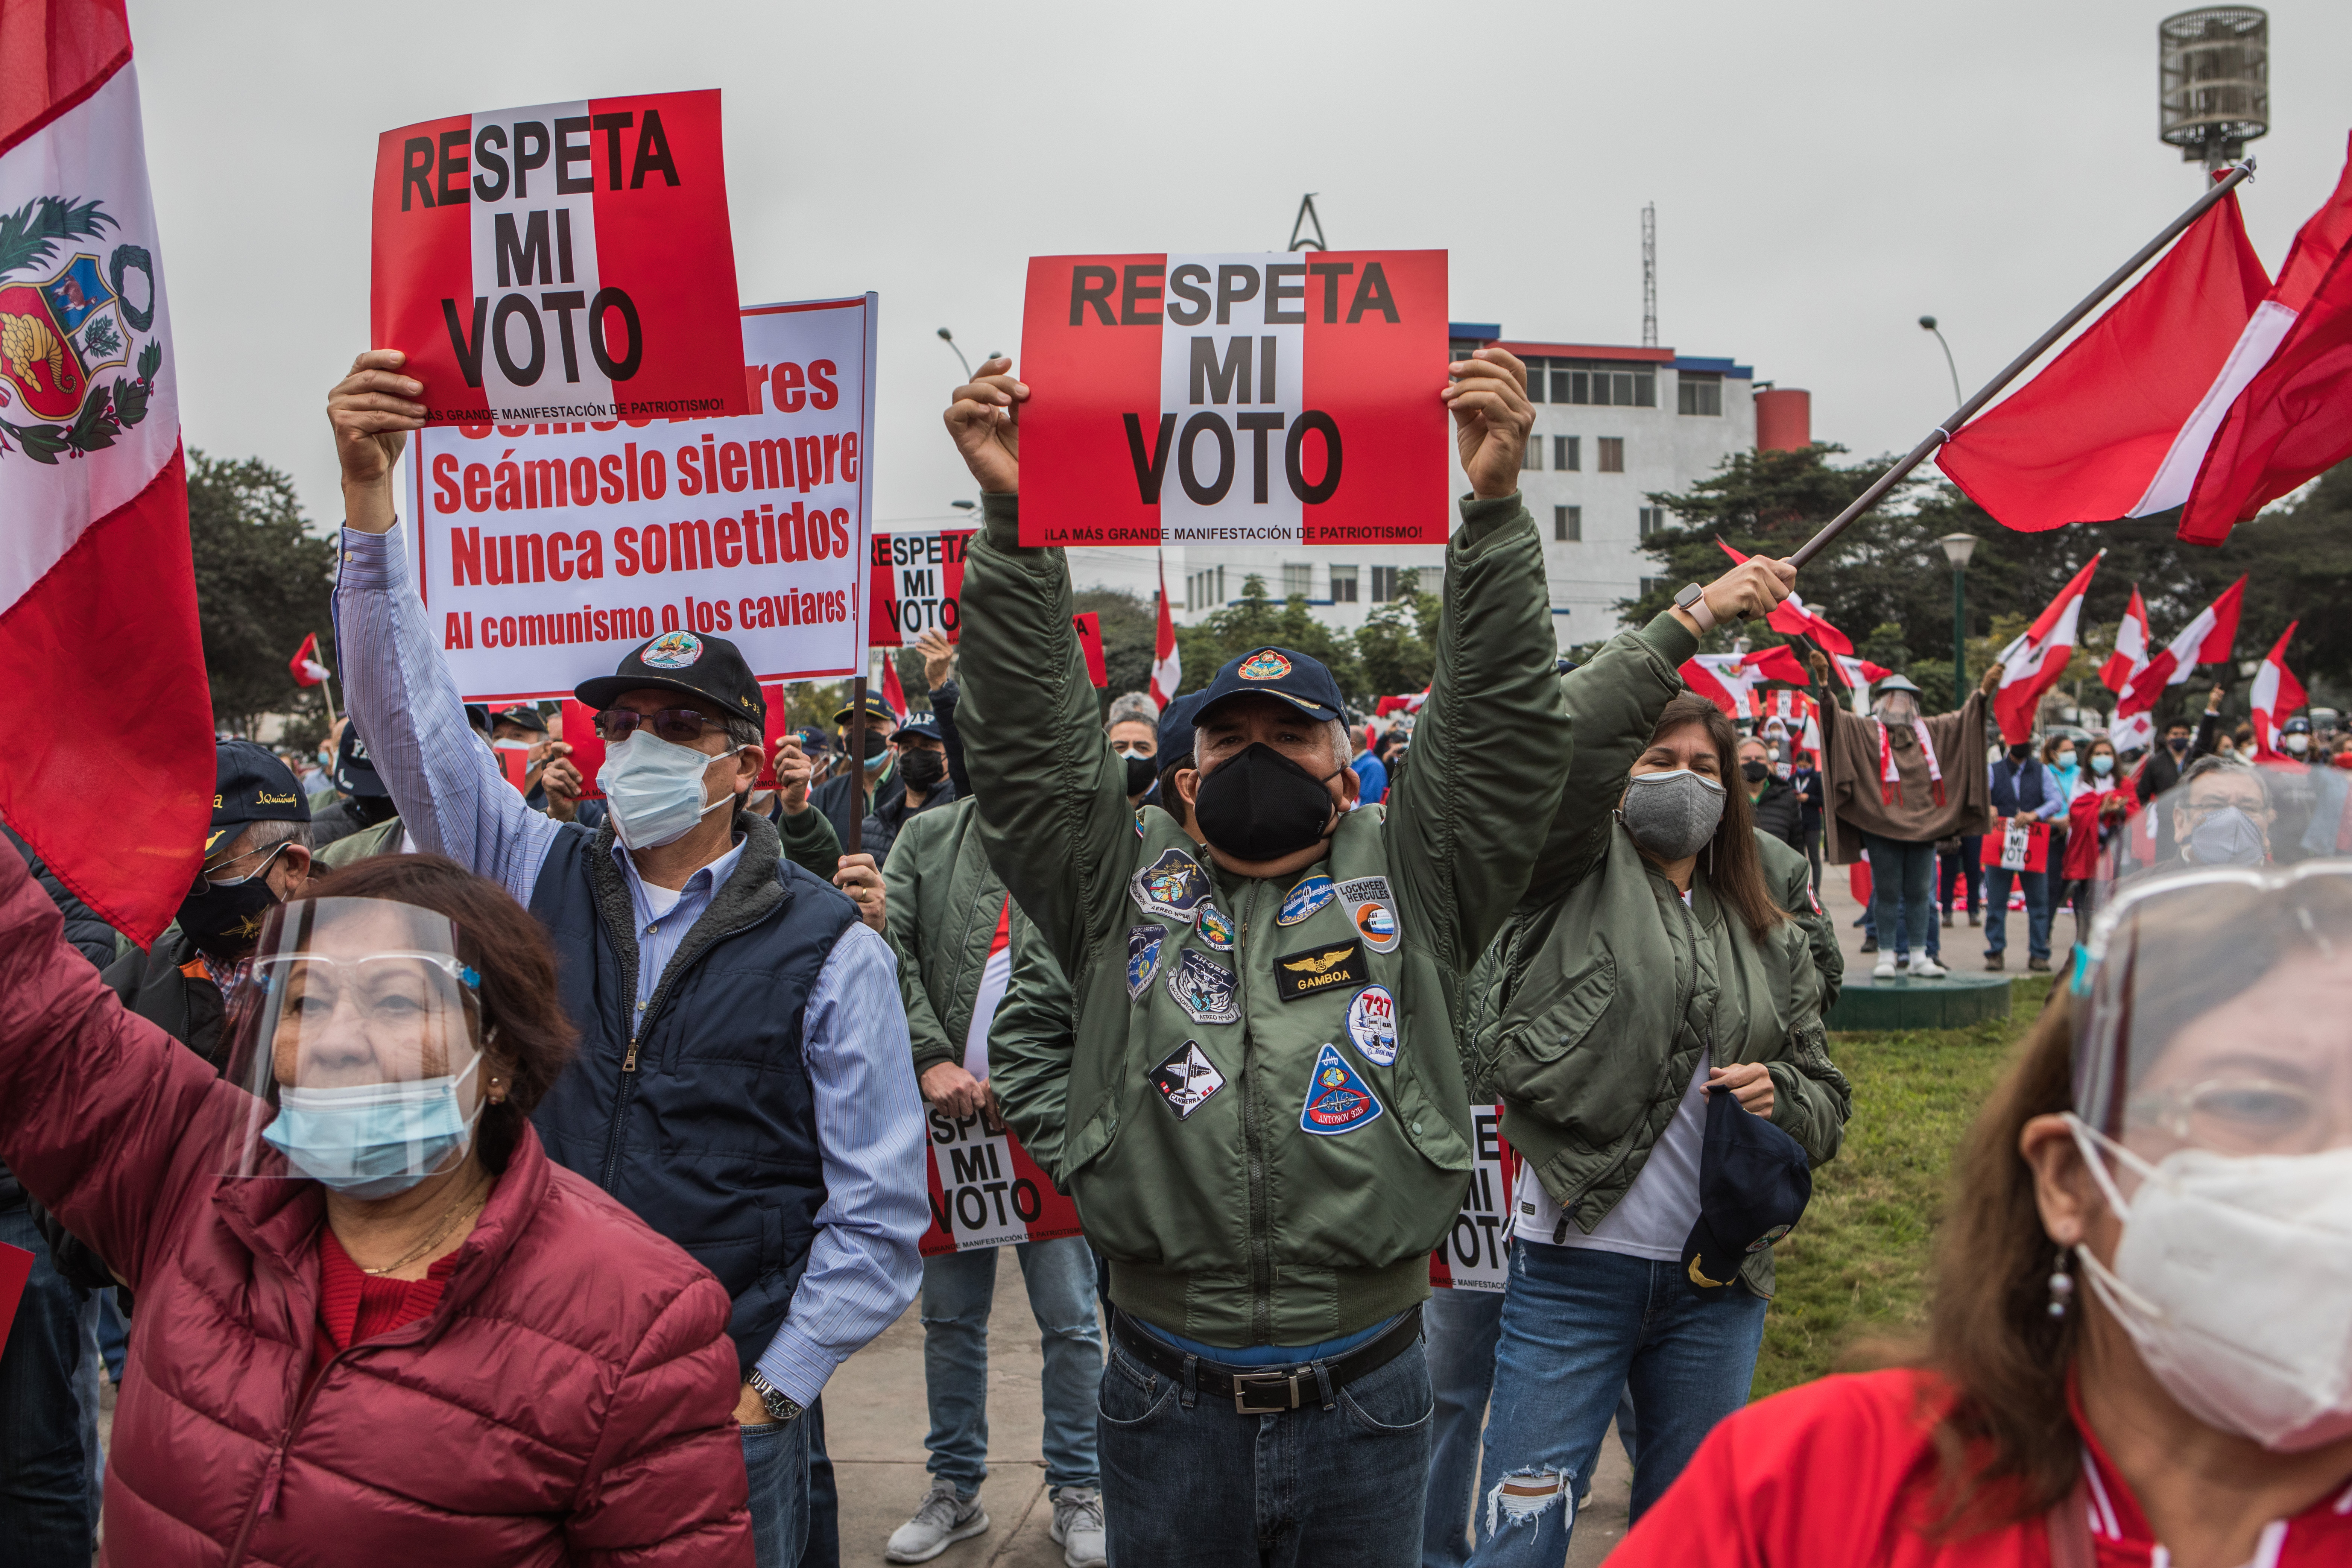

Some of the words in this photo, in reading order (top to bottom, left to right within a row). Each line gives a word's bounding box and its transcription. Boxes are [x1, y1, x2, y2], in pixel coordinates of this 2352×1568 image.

[401, 109, 681, 212] RESPETA
[495, 208, 575, 287] MI
[1068, 262, 1401, 326] RESPETA
[441, 286, 643, 388] VOTO
[1189, 336, 1277, 405] MI
[447, 409, 499, 421] GRANDE
[501, 402, 606, 419] MANIFESTACIÓN
[609, 404, 628, 415] DE
[631, 398, 724, 414] PATRIOTISMO!
[1123, 409, 1343, 506] VOTO
[433, 442, 668, 514] Seámoslo
[678, 430, 858, 497] siempre
[451, 527, 603, 587] Nunca
[615, 500, 850, 576] sometidos
[1044, 528, 1069, 541] ¡LA
[1072, 525, 1104, 541] MÁS
[1108, 528, 1169, 541] GRANDE
[1174, 525, 1292, 540] MANIFESTACIÓN
[1296, 527, 1317, 539] DE
[1320, 527, 1423, 539] PATRIOTISMO!
[903, 570, 934, 597] MI
[444, 611, 474, 650] Al
[480, 604, 650, 649] comunismo
[661, 602, 679, 636] o
[685, 595, 734, 635] los
[739, 587, 846, 631] caviares
[885, 597, 960, 633] VOTO
[904, 713, 935, 729] FAP
[1998, 845, 2032, 864] VOTO
[2010, 836, 2024, 847] MI
[1132, 880, 1147, 906] ESCUADRON
[1340, 881, 1385, 895] LOCKHEED
[1346, 890, 1390, 903] HERCULES
[1151, 906, 1173, 915] AEREO
[1282, 893, 1334, 922] DRAGONFLY
[1298, 970, 1351, 990] GAMBOA
[1170, 984, 1196, 1014] ESCUADRON
[1362, 994, 1392, 1019] 737
[1375, 1048, 1394, 1058] BOEING
[1170, 1094, 1202, 1105] CANBERRA
[1318, 1113, 1349, 1124] ANTONOV
[1351, 1106, 1363, 1118] 32B
[949, 1143, 1001, 1184] MI
[928, 1178, 1042, 1234] VOTO
[929, 1243, 961, 1254] GRANDE
[962, 1234, 1023, 1249] MANIFESTACIÓN
